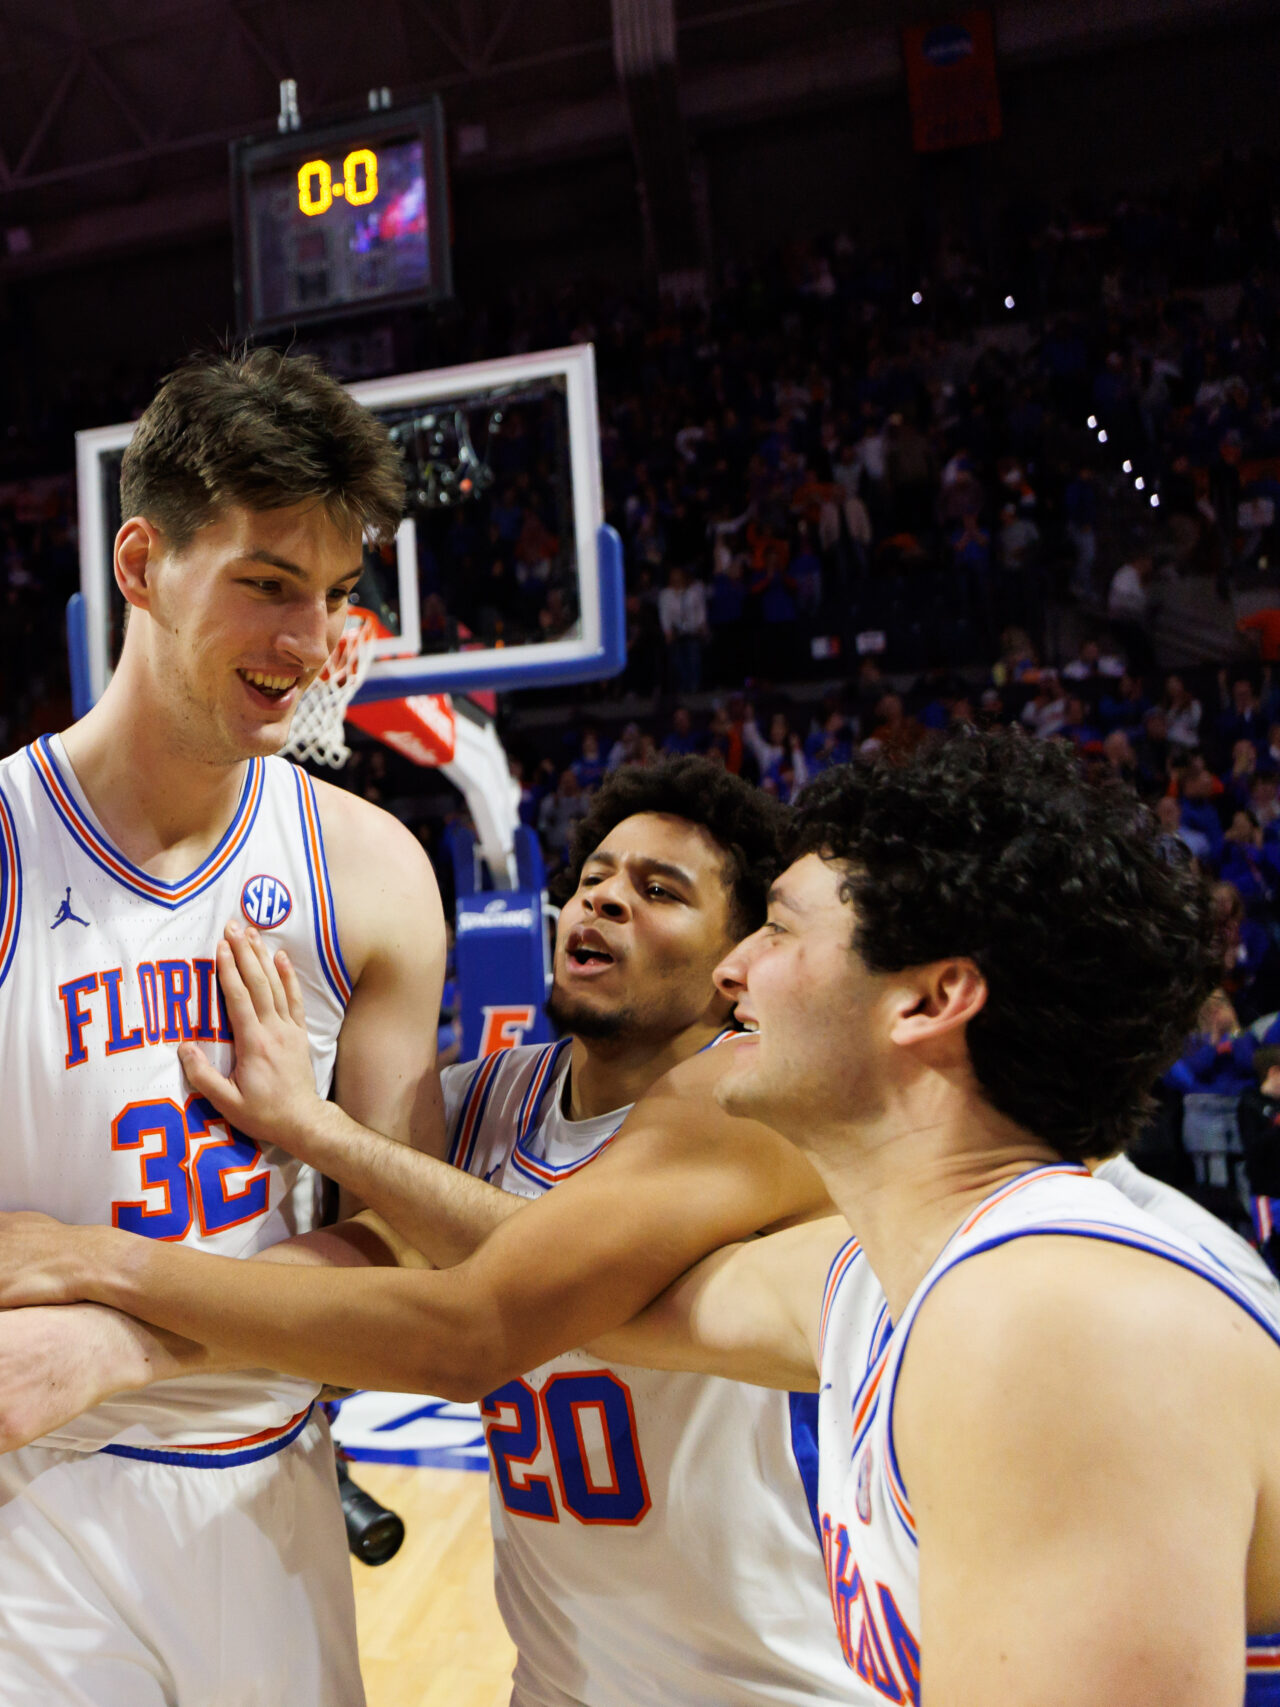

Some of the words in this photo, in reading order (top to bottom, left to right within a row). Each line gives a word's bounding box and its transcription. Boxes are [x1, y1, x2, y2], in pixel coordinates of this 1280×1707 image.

[244, 876, 290, 927] SEC
[59, 958, 234, 1070] FLORI
[111, 1092, 271, 1242] 32
[481, 1369, 652, 1526] 20
